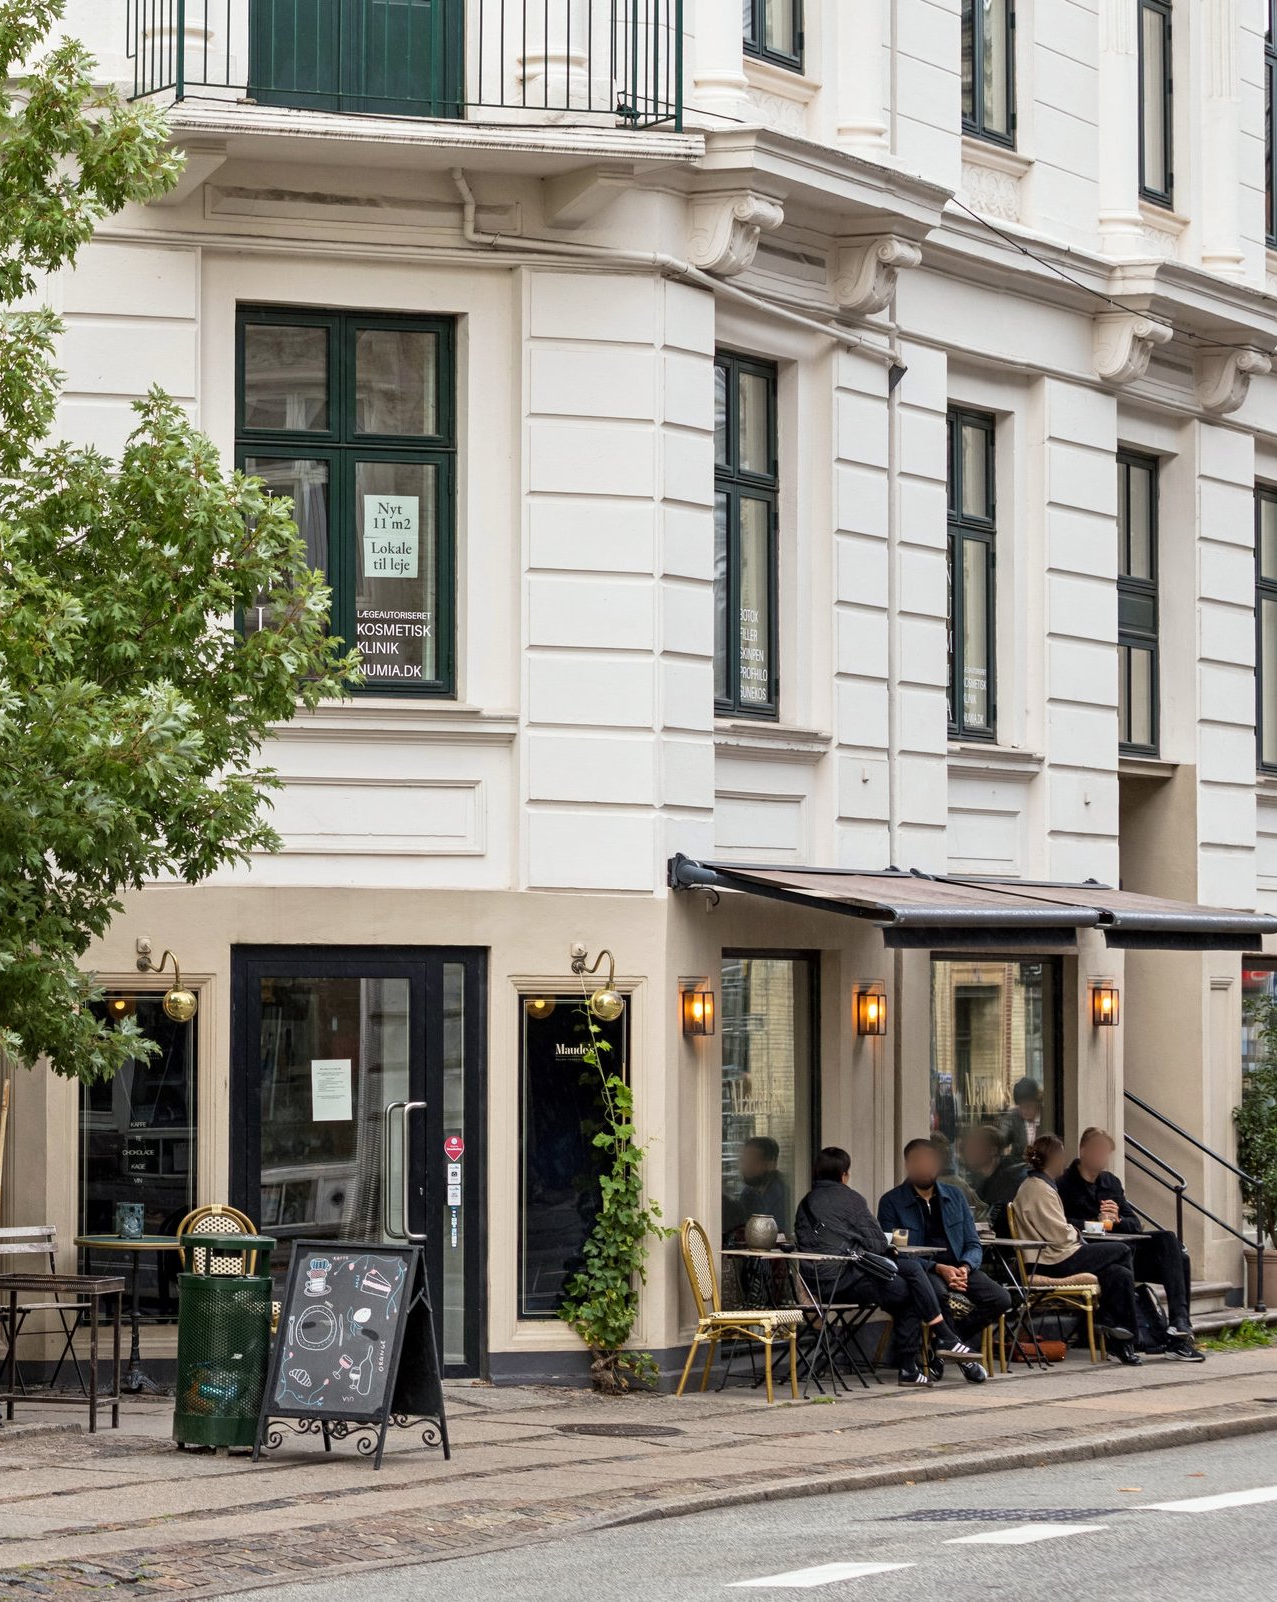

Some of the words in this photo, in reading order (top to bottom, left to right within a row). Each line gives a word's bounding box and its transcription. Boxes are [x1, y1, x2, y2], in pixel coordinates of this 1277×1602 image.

[378, 502, 403, 519] Nyt
[374, 518, 387, 529] 11
[391, 518, 411, 530] m2
[371, 541, 412, 555] Lokale
[373, 557, 387, 570] til
[390, 557, 411, 575] leje
[357, 610, 432, 620] LÆGEAUTORISERET
[356, 622, 432, 637] KOSMETISK
[356, 641, 400, 655] KLINIK
[357, 663, 422, 678] NUMIA.DK
[555, 1043, 595, 1055] Maude's
[378, 1340, 387, 1372] ORANGE
